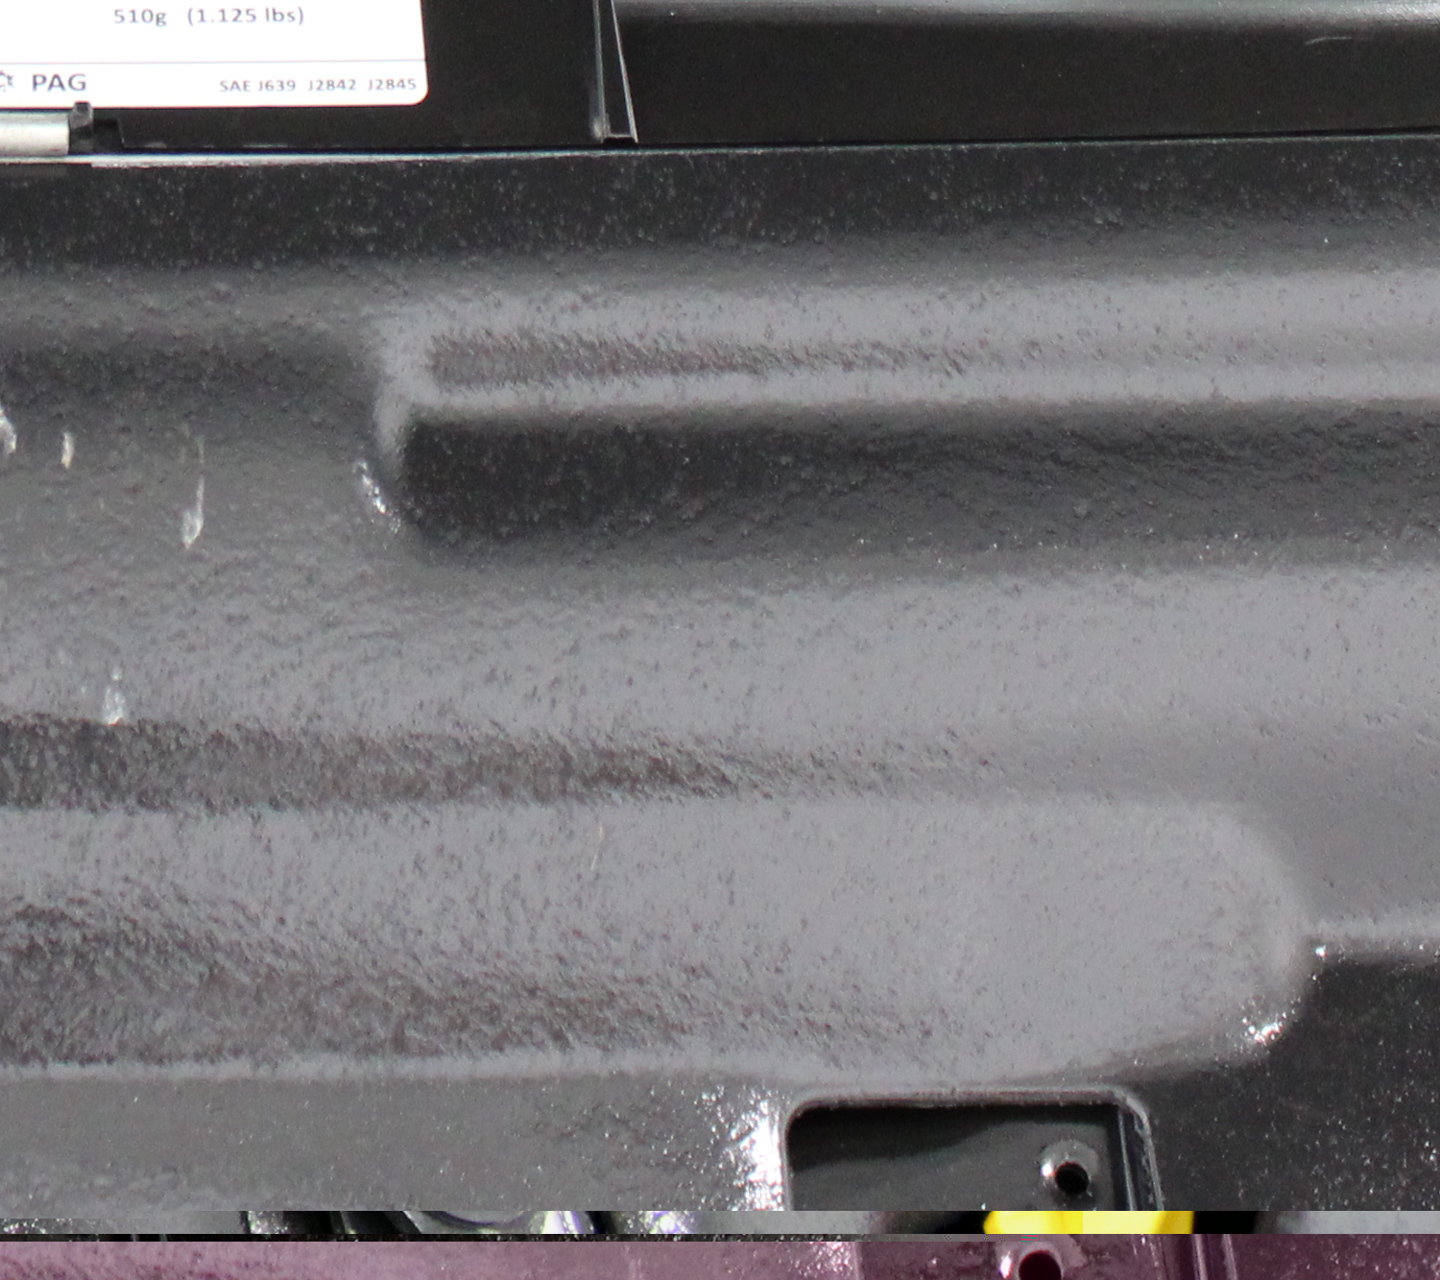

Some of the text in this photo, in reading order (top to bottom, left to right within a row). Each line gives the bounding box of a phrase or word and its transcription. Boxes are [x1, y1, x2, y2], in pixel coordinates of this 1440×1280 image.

[113, 5, 307, 31] 510g (1.125 lbs)
[31, 71, 418, 94] PAG SAE J639 J2842 J2845
